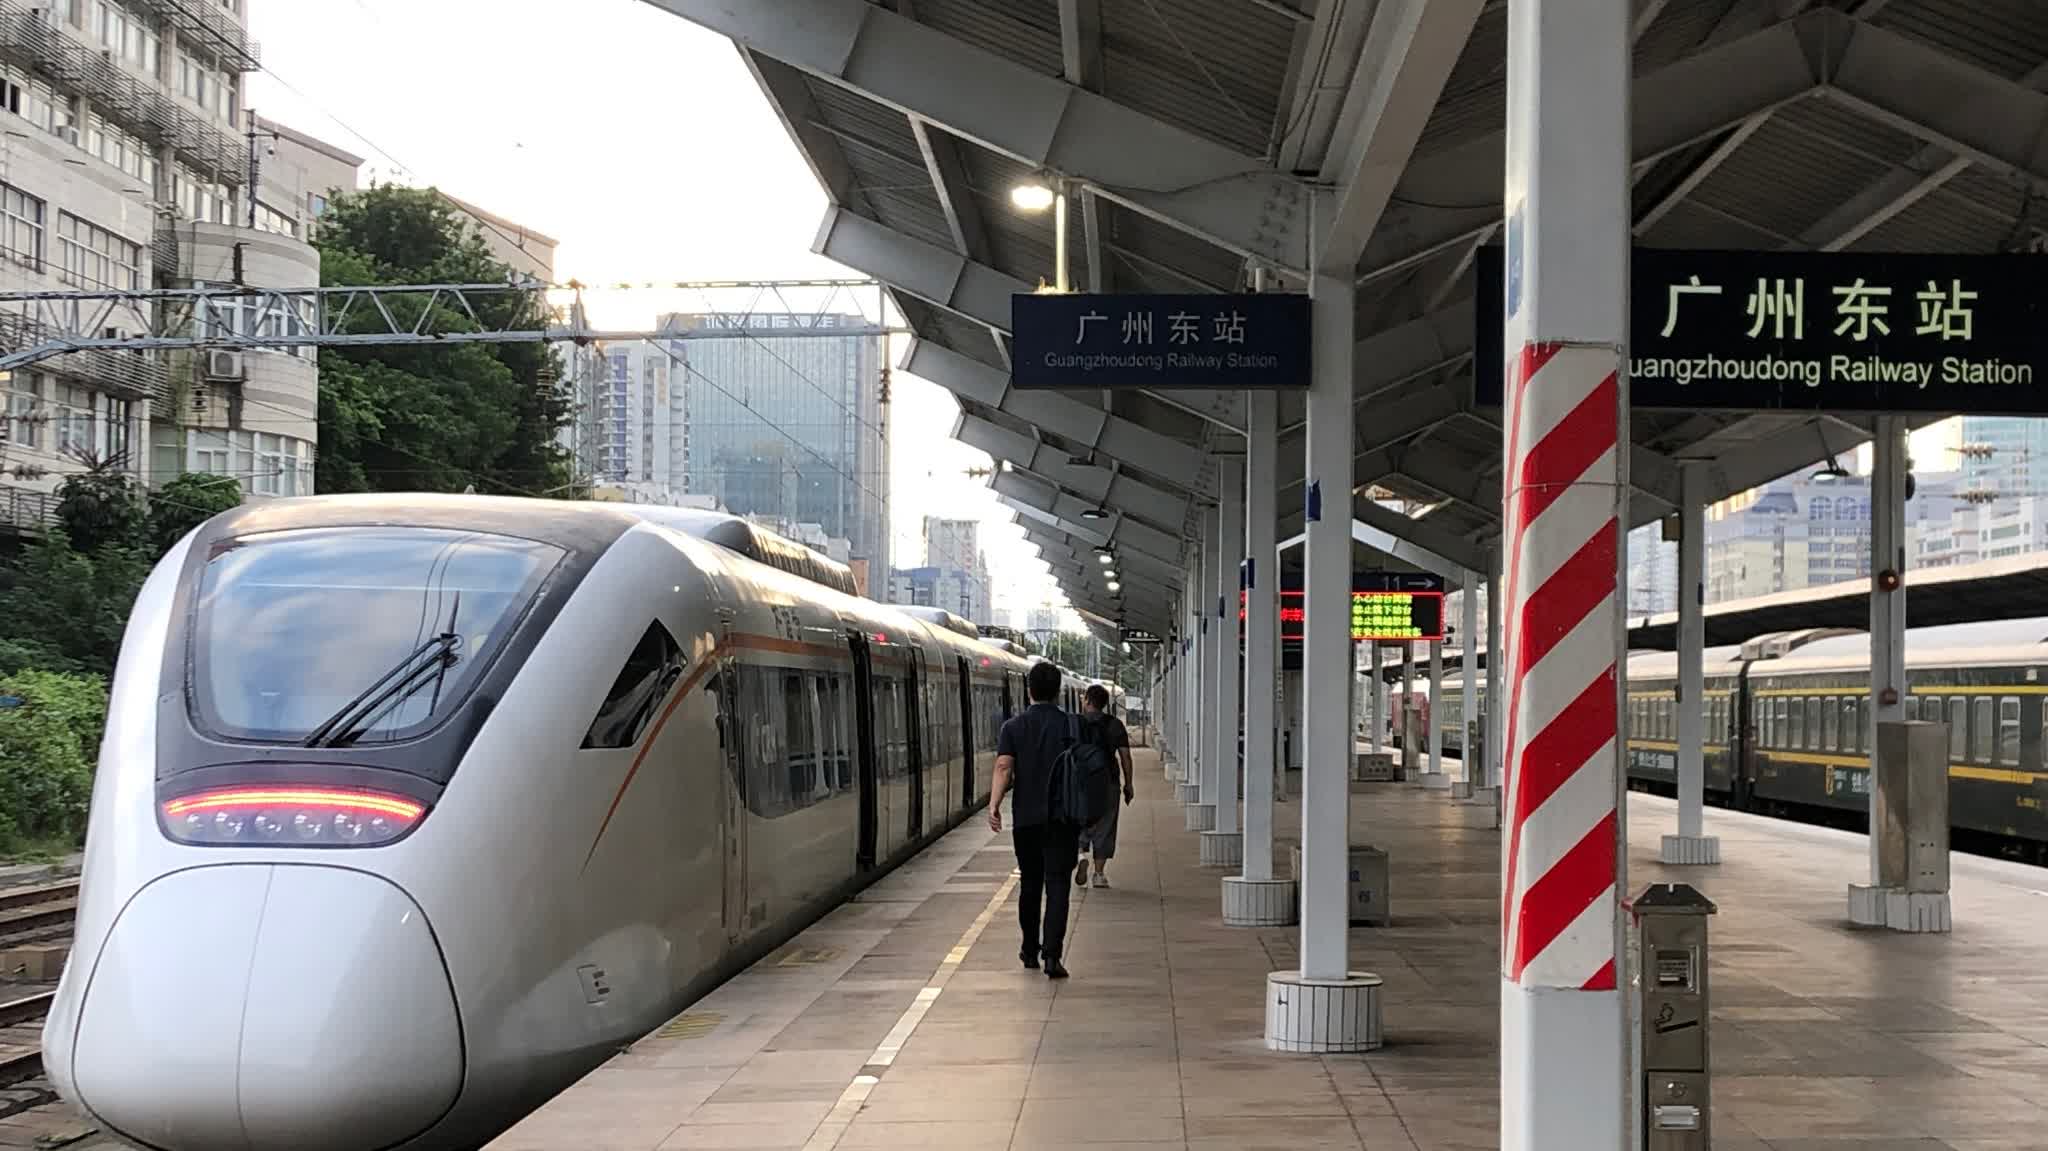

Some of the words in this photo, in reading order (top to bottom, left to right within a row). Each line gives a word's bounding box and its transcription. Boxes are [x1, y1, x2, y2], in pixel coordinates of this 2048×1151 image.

[1660, 275, 1978, 341] 广州东站
[1075, 310, 1247, 345] 广州东站
[1044, 351, 1163, 370] Guangzhoudong
[1167, 352, 1223, 370] Railway
[1226, 352, 1278, 368] Station
[1630, 353, 1821, 387] uangzhoudong
[1830, 355, 1933, 389] Railway
[1942, 356, 2032, 384] Station
[1384, 575, 1400, 591] 11
